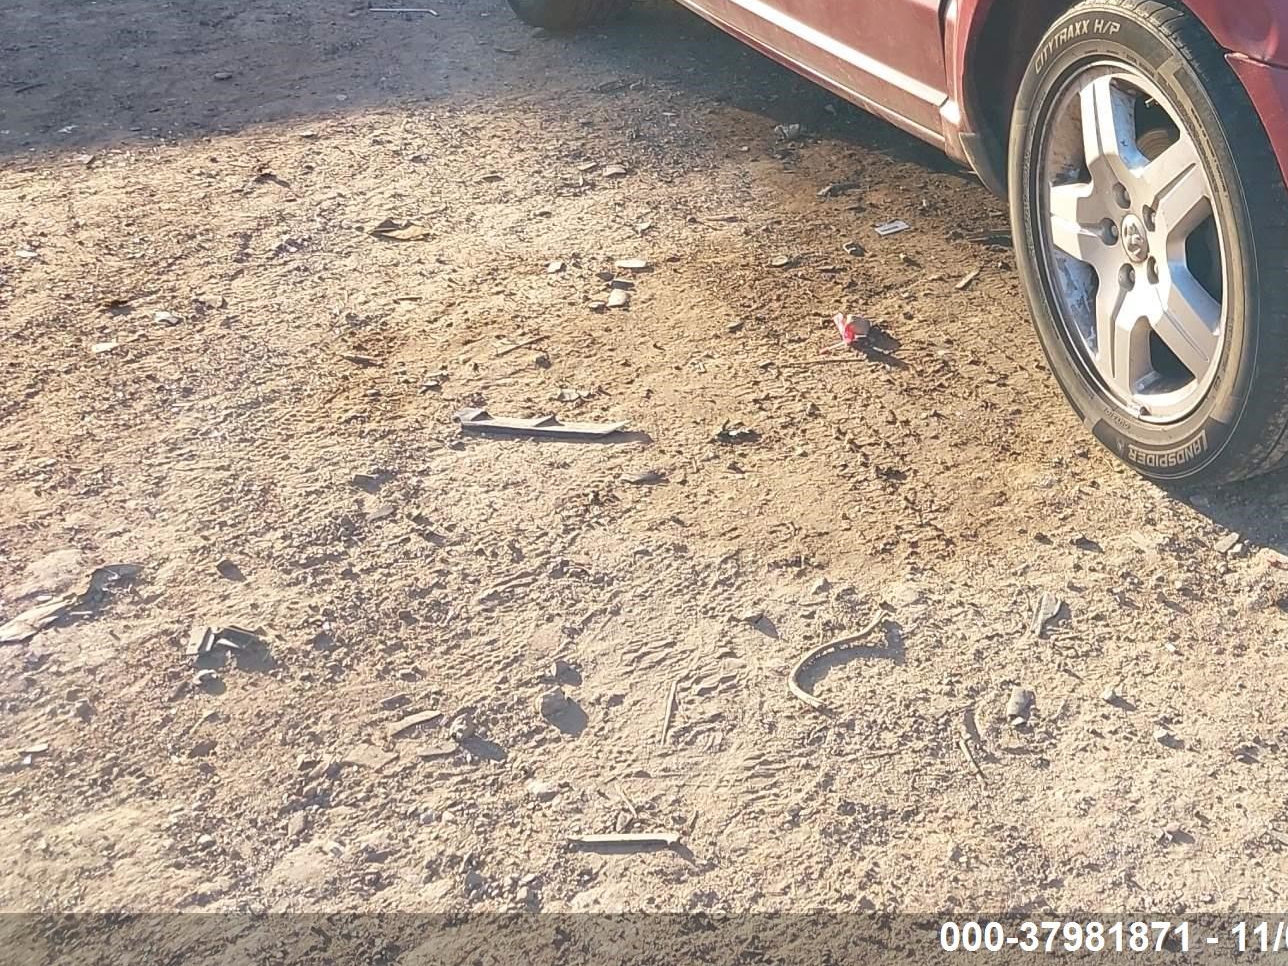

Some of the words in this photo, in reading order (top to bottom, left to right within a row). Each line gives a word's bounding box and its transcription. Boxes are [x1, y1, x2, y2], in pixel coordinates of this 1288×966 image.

[1035, 19, 1090, 75] CITYTRAXX
[1093, 18, 1121, 35] H/P
[1128, 429, 1209, 467] LANDSPIDER
